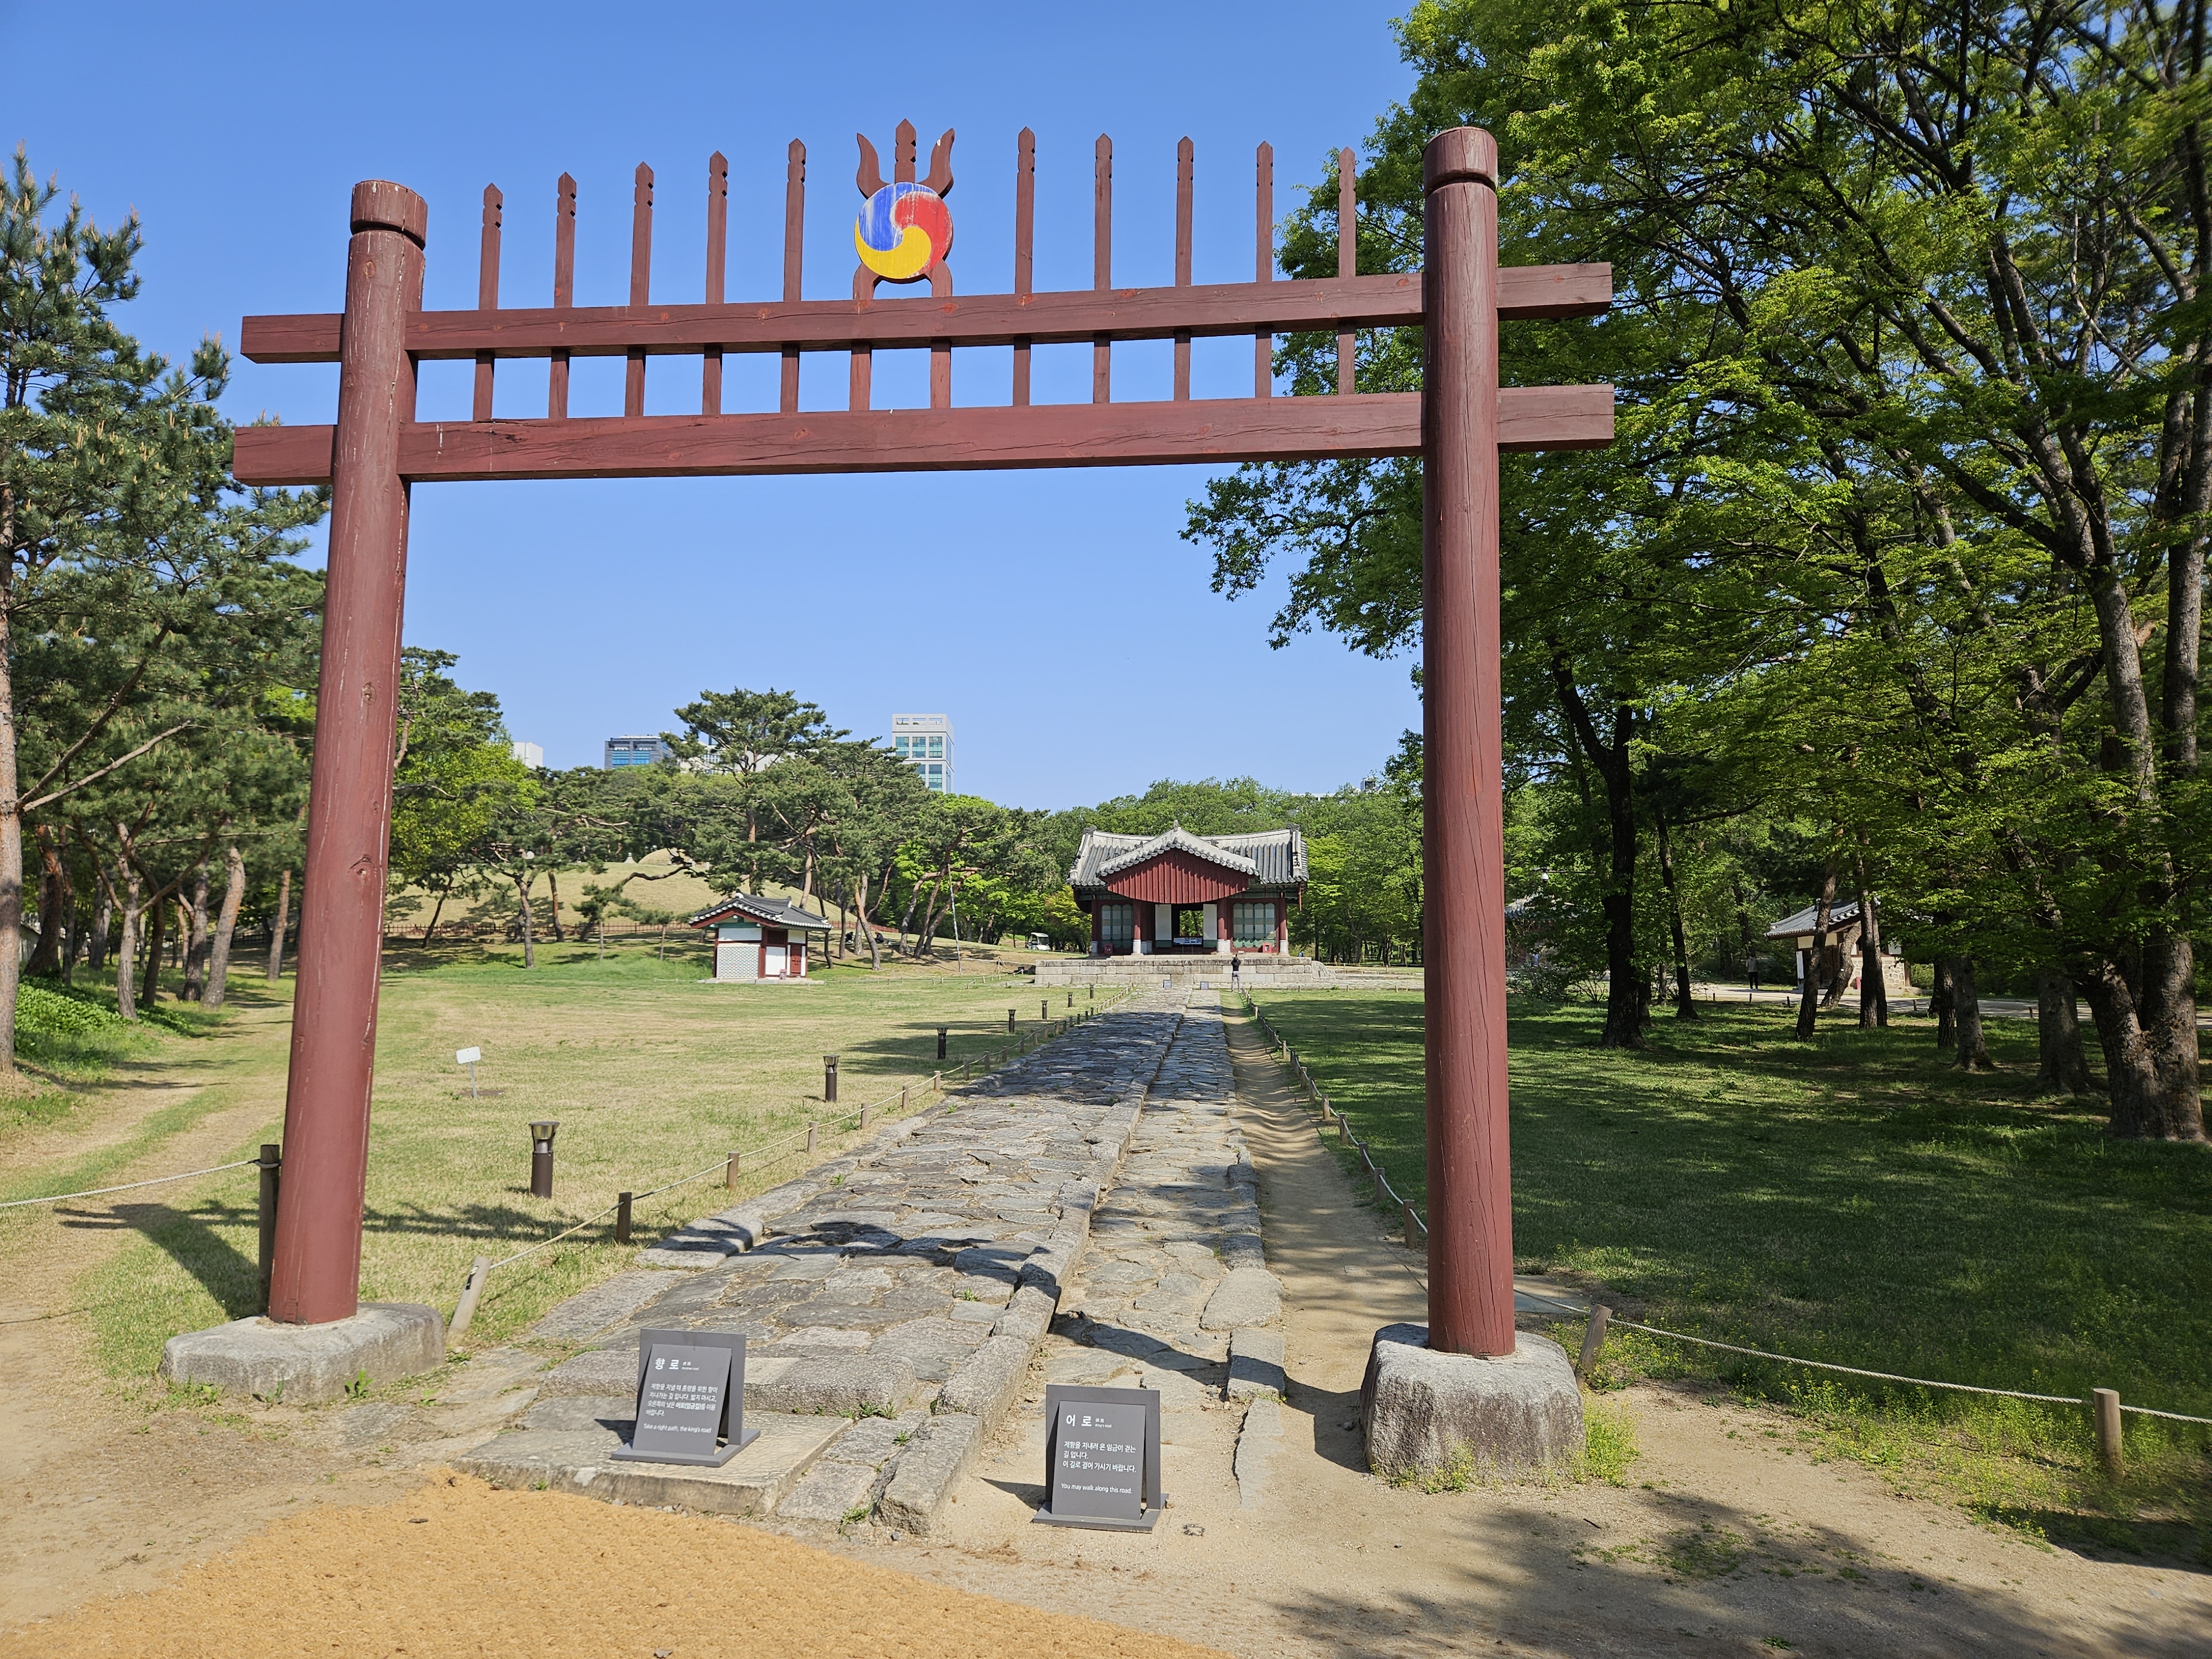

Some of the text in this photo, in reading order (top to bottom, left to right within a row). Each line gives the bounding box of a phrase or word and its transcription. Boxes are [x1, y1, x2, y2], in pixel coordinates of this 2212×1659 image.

[1064, 1441, 1081, 1449] 제향을
[1082, 1442, 1099, 1450] 지내러
[1107, 1444, 1123, 1452] 임금이
[1125, 1445, 1136, 1453] 걷는
[1070, 1451, 1089, 1459] 입니다.
[1070, 1460, 1081, 1469] 길로
[1082, 1462, 1093, 1470] 걸어
[1094, 1462, 1111, 1471] 가시기
[1112, 1464, 1136, 1473] 바랍니다.
